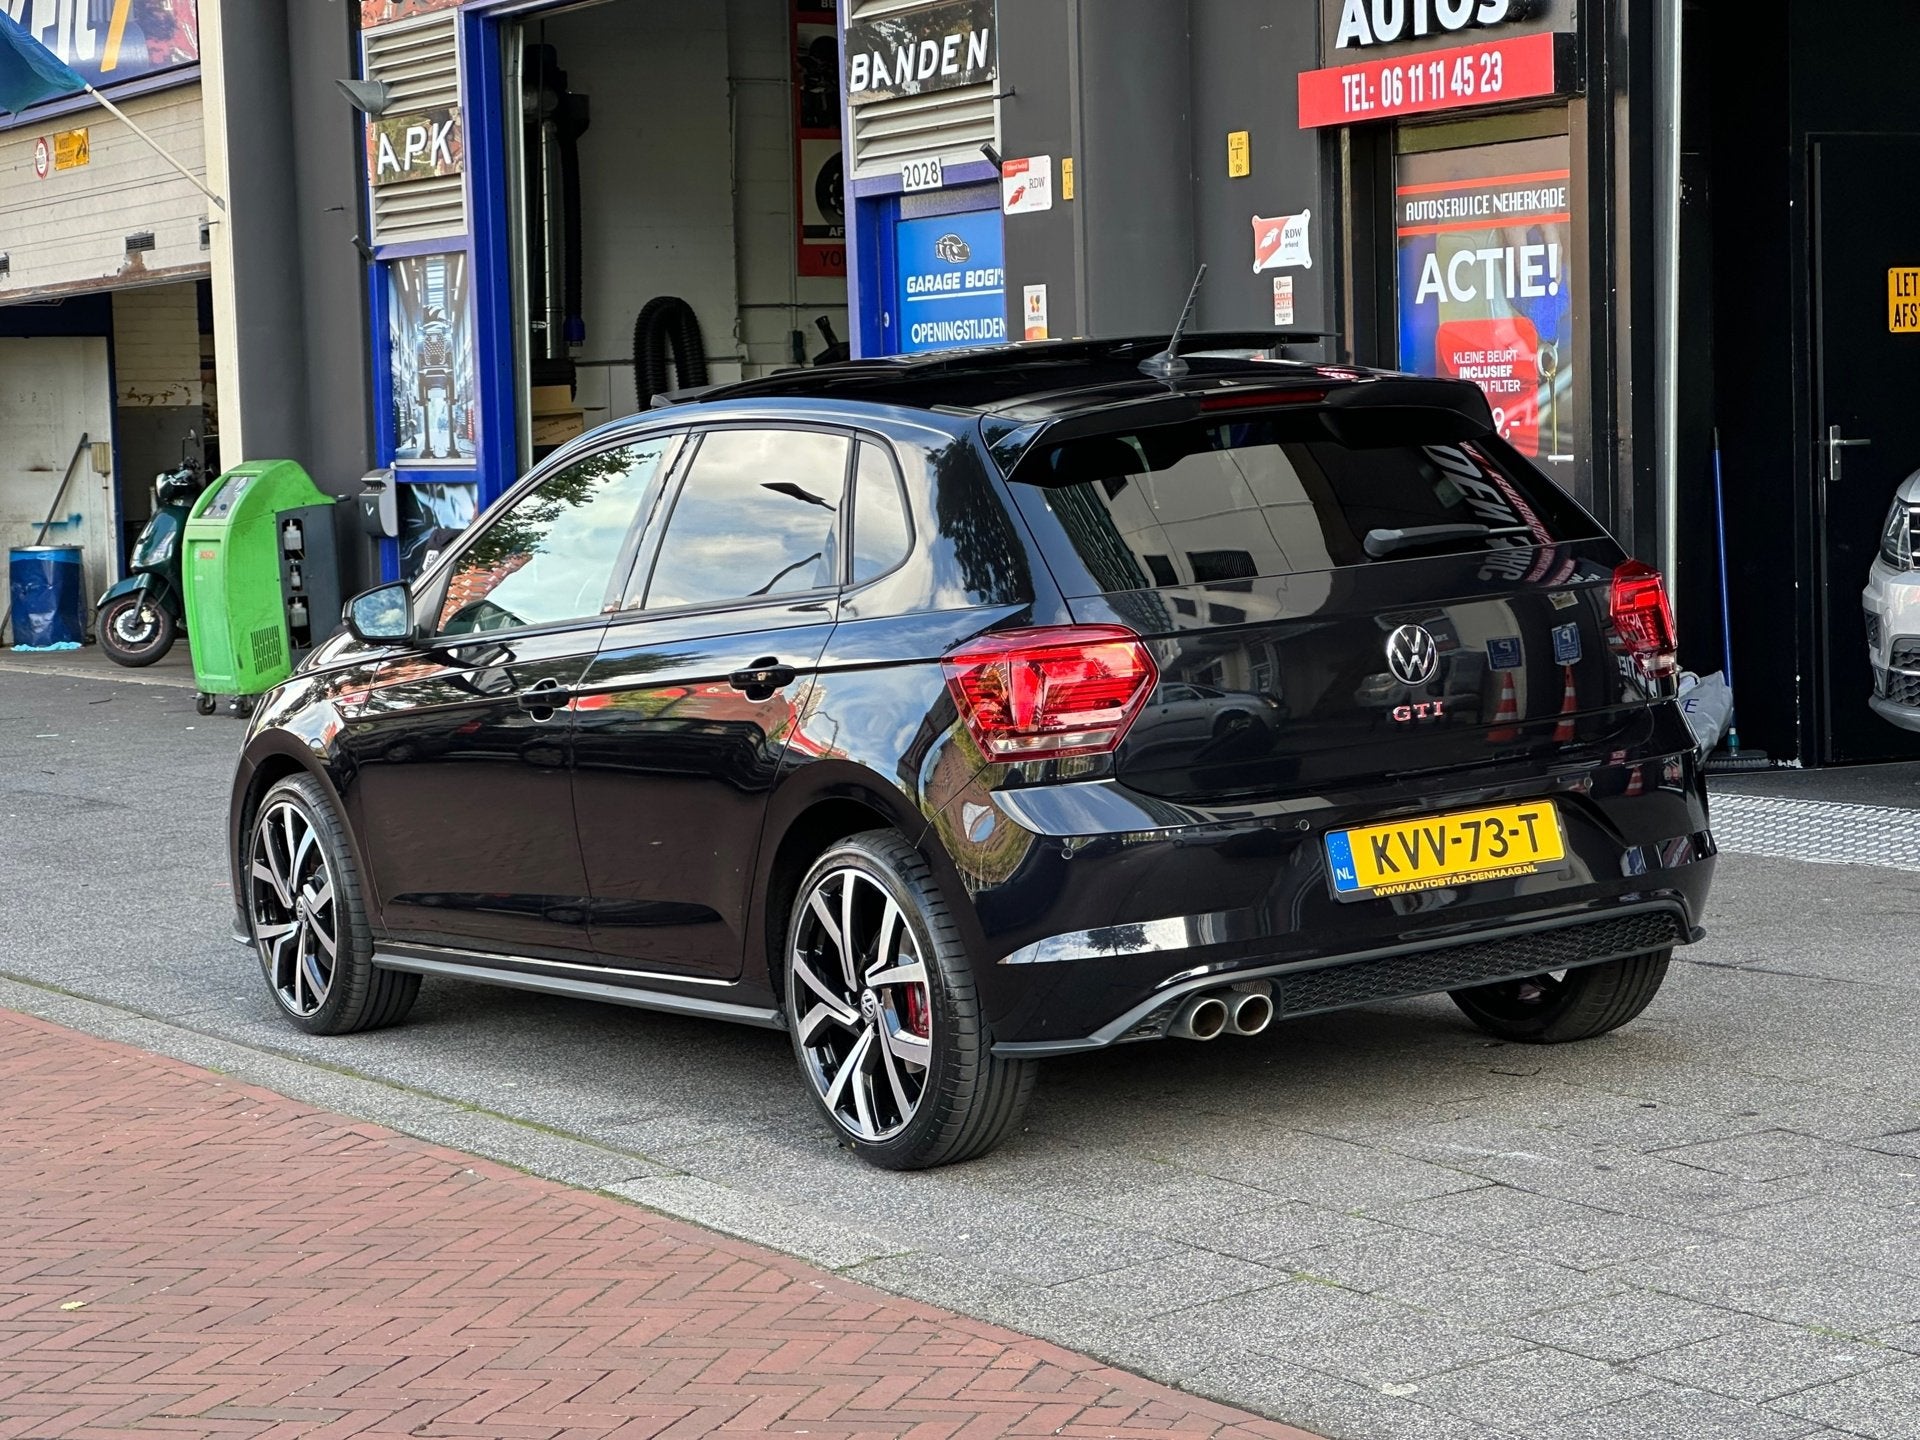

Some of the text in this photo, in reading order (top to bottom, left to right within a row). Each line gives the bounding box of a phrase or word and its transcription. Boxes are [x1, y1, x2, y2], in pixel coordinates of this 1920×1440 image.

[850, 28, 990, 93] BANDEN
[1341, 51, 1503, 113] TEL: 06 11 11 45 23
[377, 120, 455, 175] APK
[904, 160, 940, 188] 2028
[1028, 176, 1046, 189] RDW
[1406, 187, 1566, 222] AUTOSERVICE NEHERKADE
[1284, 227, 1303, 240] RDW
[906, 272, 961, 294] GARAGE
[1415, 243, 1559, 305] ACTIE!
[1896, 272, 1919, 297] LET
[1893, 303, 1920, 328] AFS
[1453, 349, 1519, 365] KLEINE BEURT
[1459, 365, 1513, 380] INCLUSIEF
[1490, 379, 1521, 393] FILTER
[1393, 701, 1444, 722] GTI
[1336, 812, 1539, 882] NL KVV-73-T
[1373, 864, 1539, 898] WWW.AUTOSTAD-DENHAAG.NL
